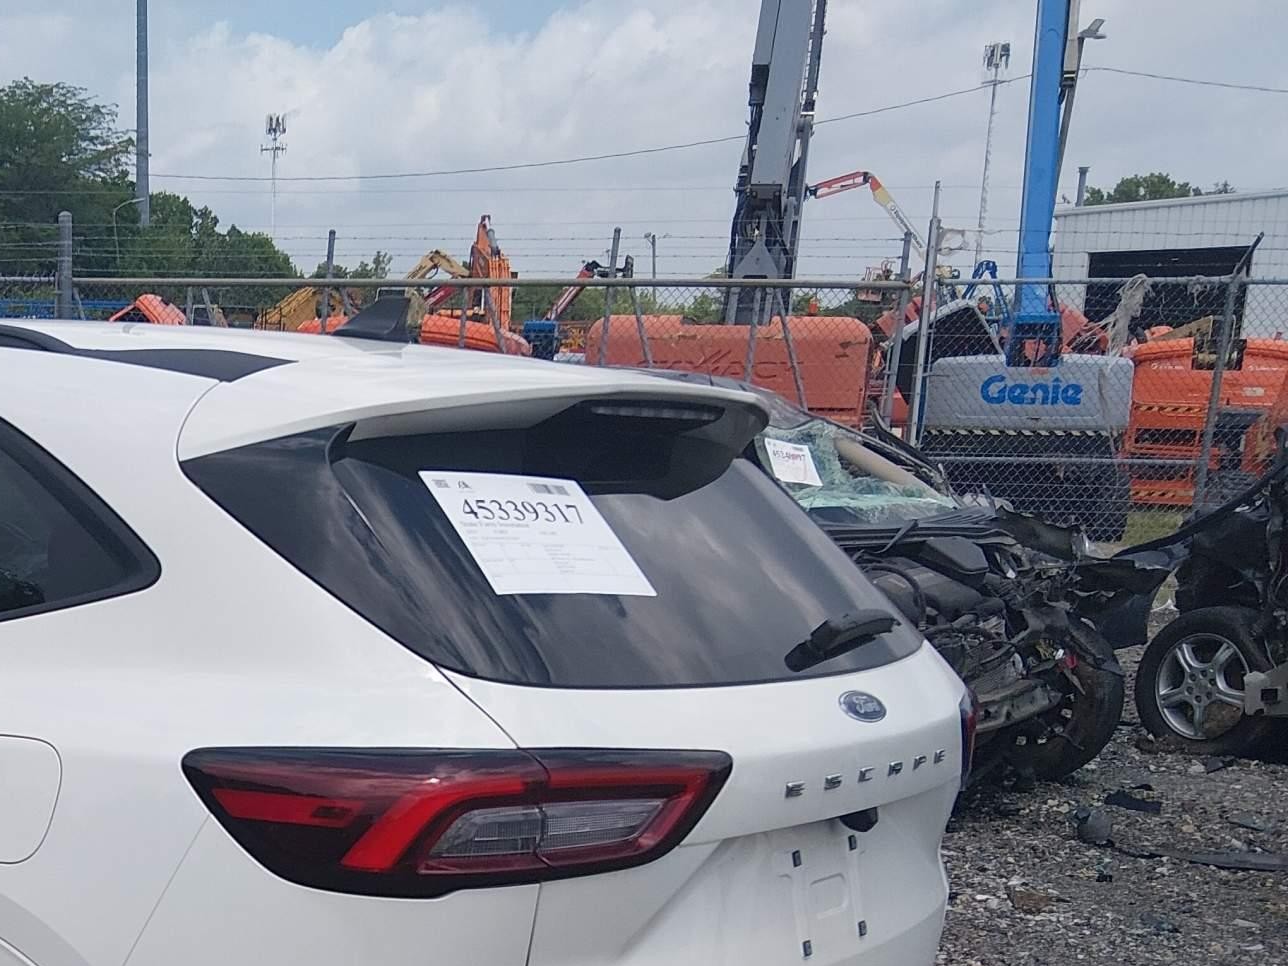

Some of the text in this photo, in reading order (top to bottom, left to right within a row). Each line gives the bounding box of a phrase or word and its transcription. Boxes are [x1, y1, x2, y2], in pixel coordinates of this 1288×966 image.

[980, 374, 1084, 406] Genie
[462, 498, 584, 525] 45339317
[784, 748, 946, 799] ESCAPE
